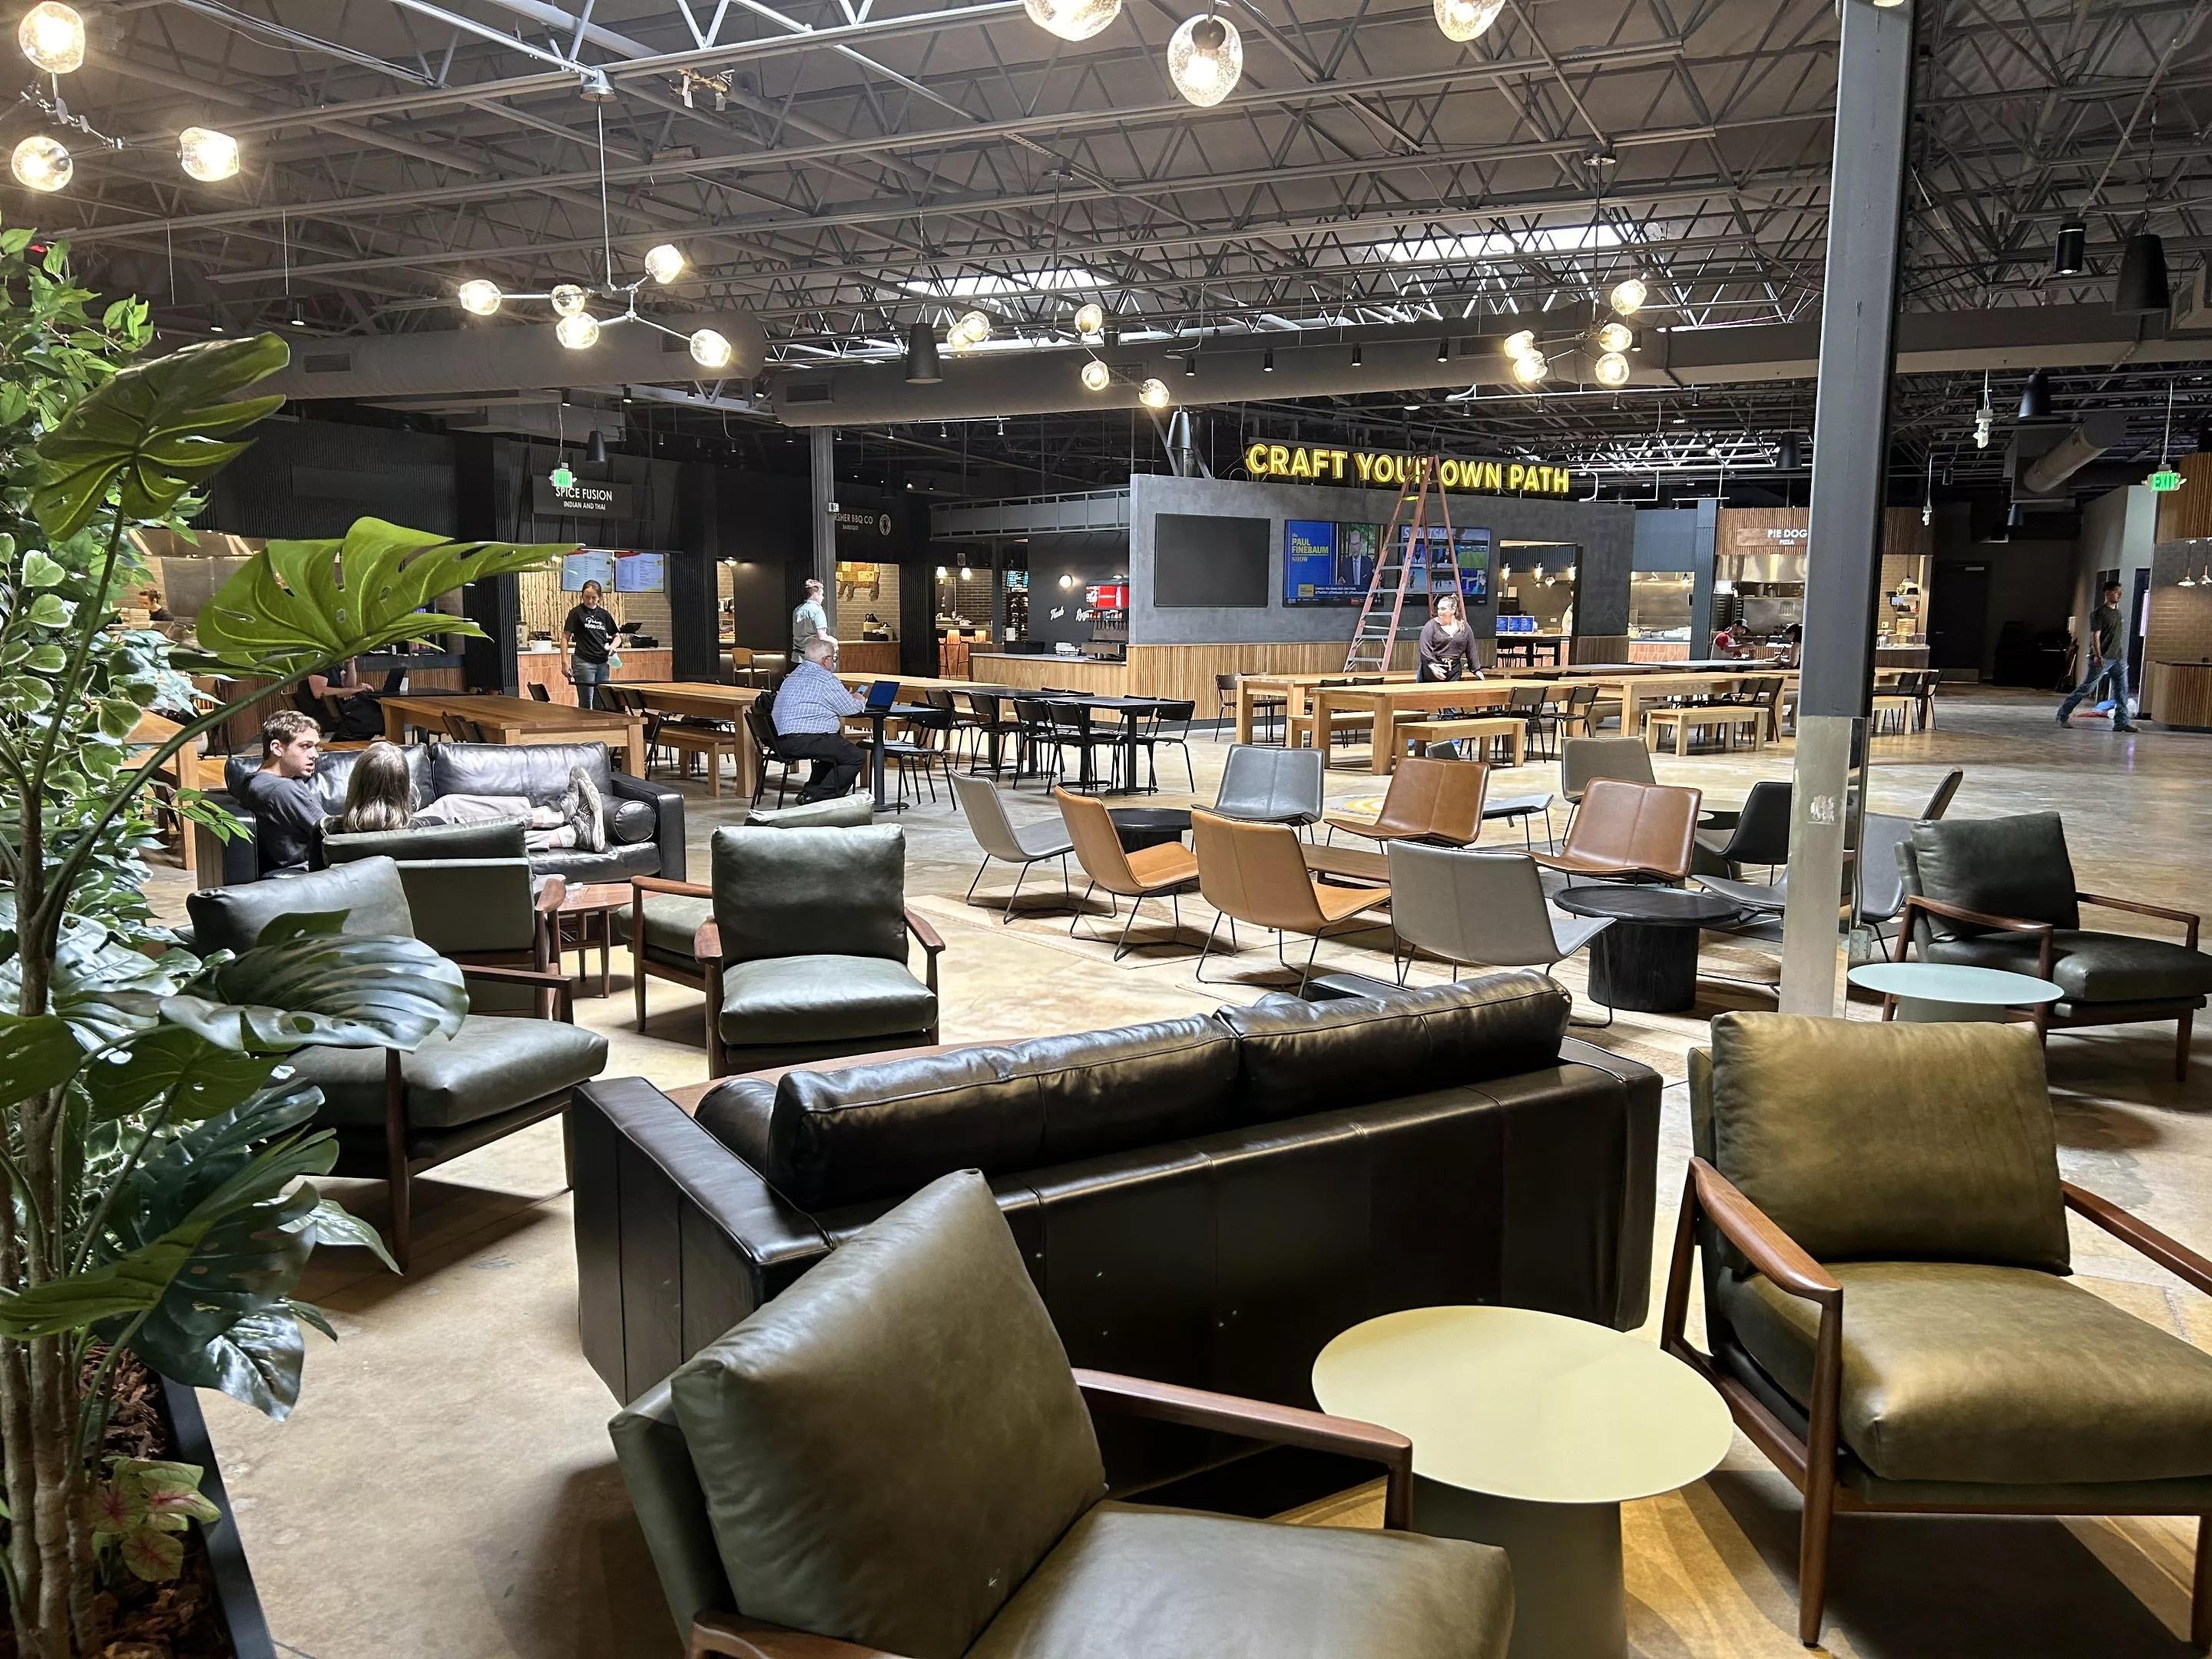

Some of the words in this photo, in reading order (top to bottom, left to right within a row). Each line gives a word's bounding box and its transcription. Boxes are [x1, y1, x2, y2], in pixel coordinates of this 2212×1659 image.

[1246, 443, 1348, 478] CRAFT
[1440, 459, 1502, 488] OWN
[1510, 464, 1569, 493] PATH
[2153, 473, 2177, 490] EXIT
[555, 486, 580, 498] SPICE
[582, 488, 613, 501] FUSION
[852, 514, 863, 524] BBQ
[864, 515, 873, 525] CO
[1767, 528, 1782, 538] PIE
[1783, 528, 1808, 538] DOG
[1291, 538, 1310, 546] PAUL
[1291, 545, 1329, 554] FINEBAUM
